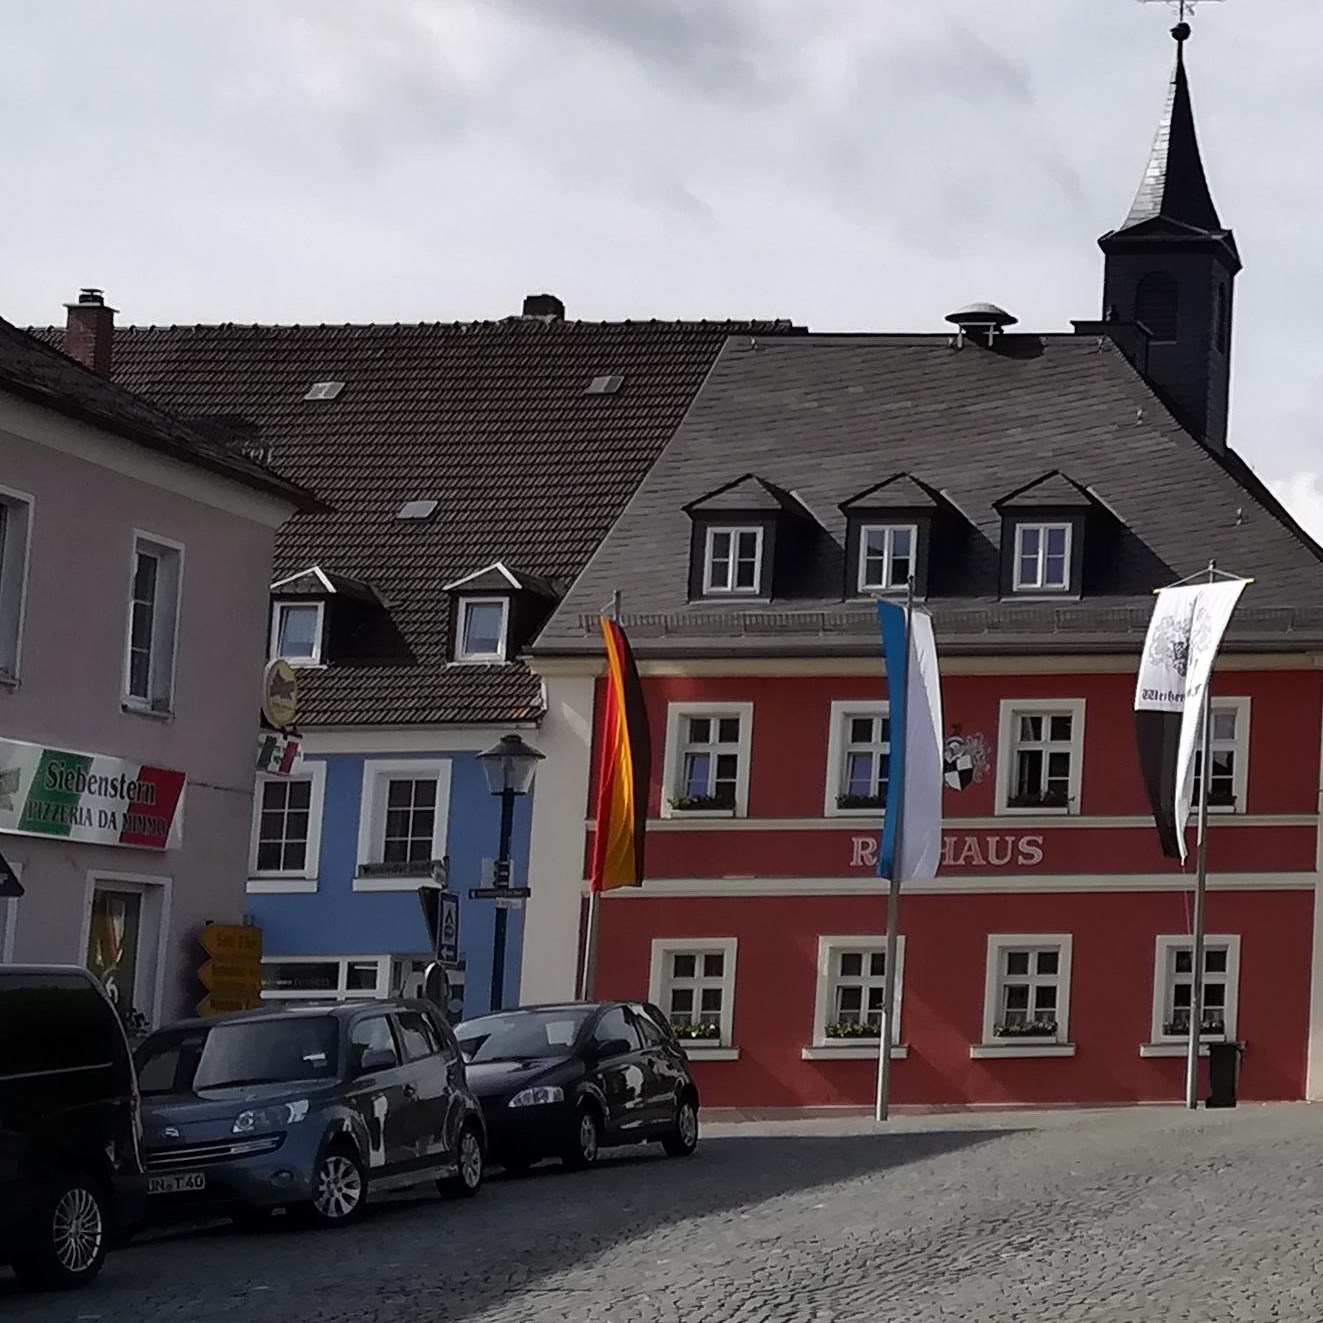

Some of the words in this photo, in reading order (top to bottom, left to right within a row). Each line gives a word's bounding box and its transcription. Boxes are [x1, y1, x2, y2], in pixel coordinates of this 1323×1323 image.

[46, 759, 156, 806] Siebenstern
[26, 799, 93, 828] PIZZERIA
[99, 809, 118, 830] DA
[850, 835, 1044, 866] RHAUS
